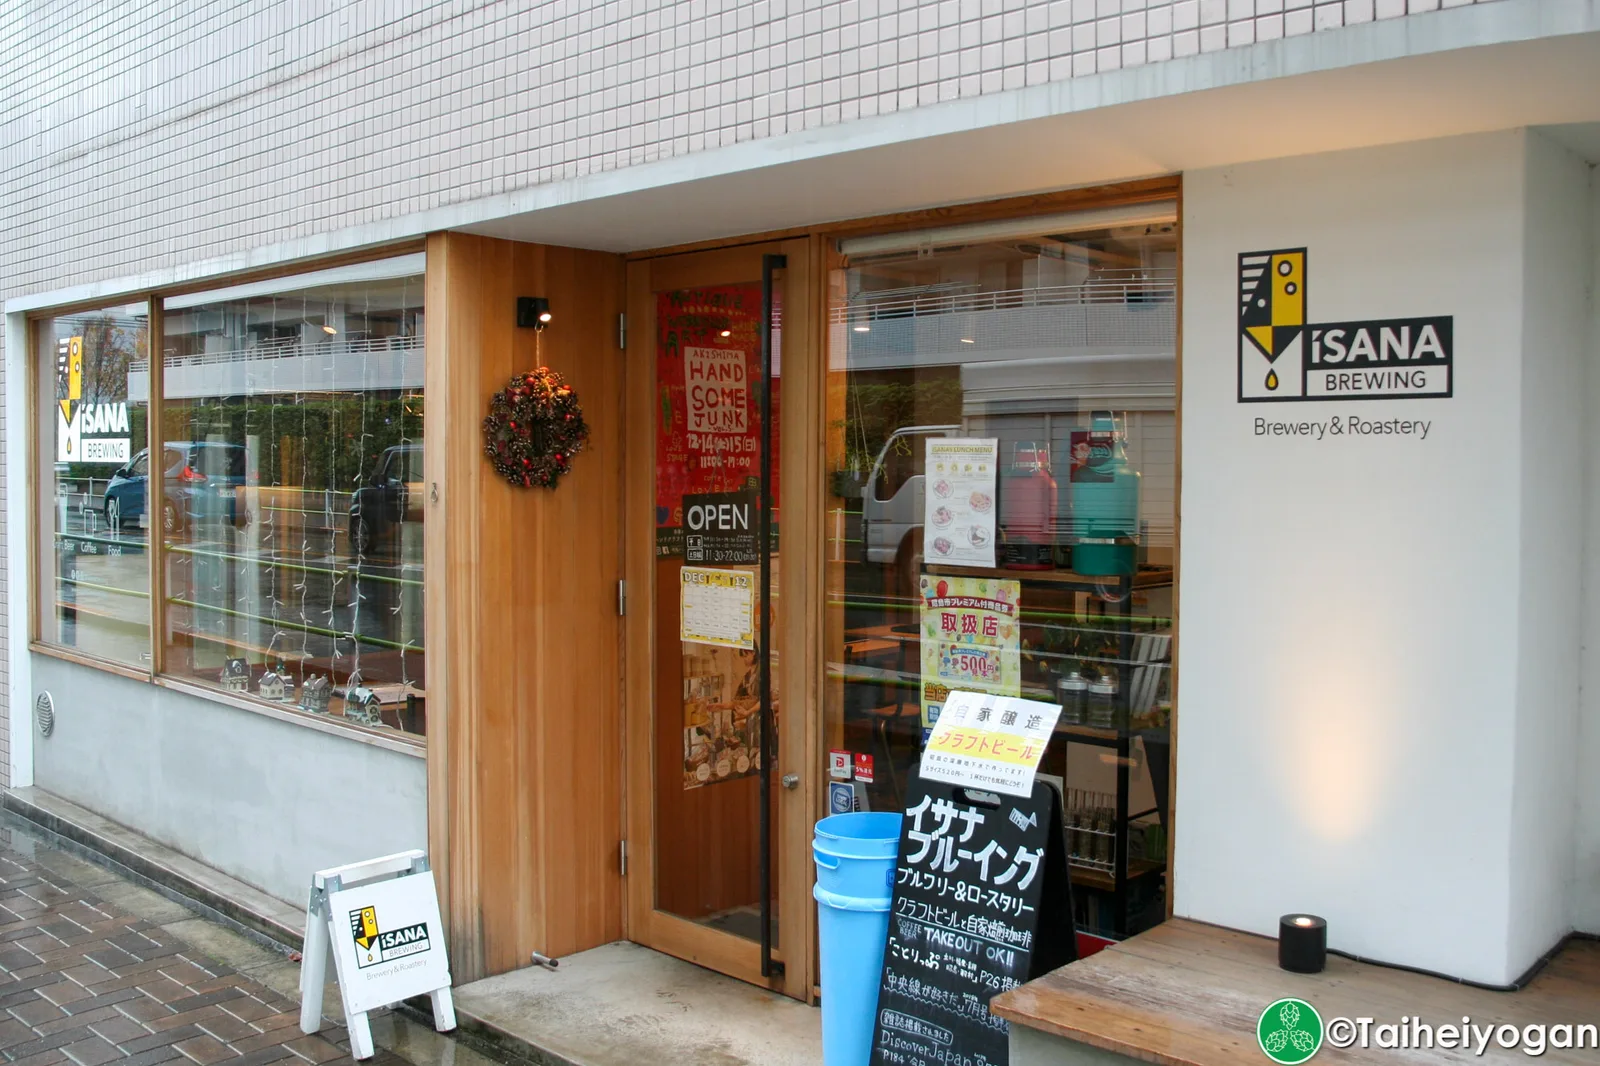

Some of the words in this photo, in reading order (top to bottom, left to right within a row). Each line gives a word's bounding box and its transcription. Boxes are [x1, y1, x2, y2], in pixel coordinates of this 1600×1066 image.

[692, 349, 739, 361] AKISHIMA
[690, 361, 744, 382] HAND
[1325, 371, 1427, 391] BREWING
[691, 385, 746, 411] SOME
[694, 410, 745, 429] JUNK
[87, 443, 124, 459] BREWING
[687, 503, 749, 531] OPEN
[80, 541, 98, 554] Coffee
[107, 544, 122, 557] Food
[684, 572, 705, 583] DEC
[735, 576, 747, 587] 12
[940, 612, 999, 637] 取扱店
[938, 731, 1033, 760] クラフトビール
[906, 794, 985, 843] イサナ
[906, 830, 1045, 890] ブルーイング
[388, 942, 424, 958] BREWING
[985, 946, 1015, 967] OK!!
